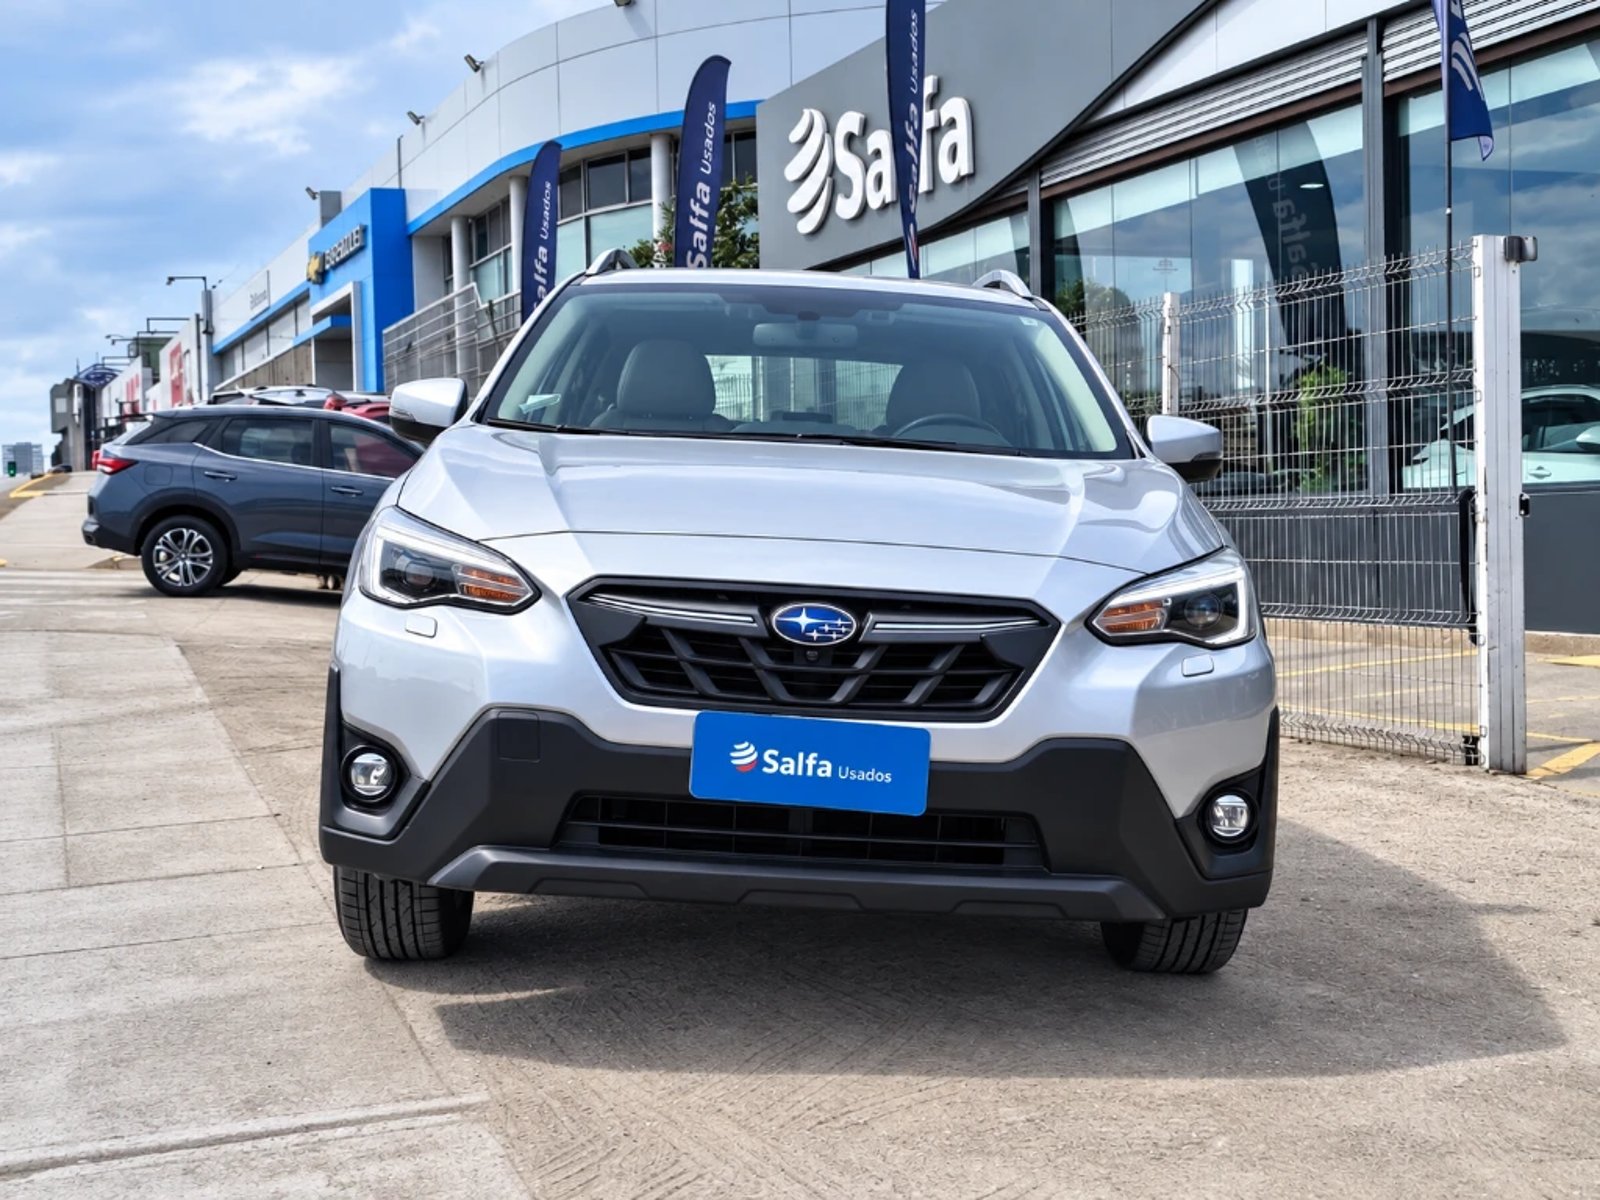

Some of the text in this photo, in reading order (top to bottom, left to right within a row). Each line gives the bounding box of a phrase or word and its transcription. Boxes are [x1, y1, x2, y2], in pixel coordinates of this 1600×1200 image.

[909, 8, 918, 94] Usados
[700, 102, 716, 174] Usados
[834, 75, 974, 220] Safa
[533, 181, 552, 310] alfa Usados
[762, 749, 892, 783] Salfa Usados
